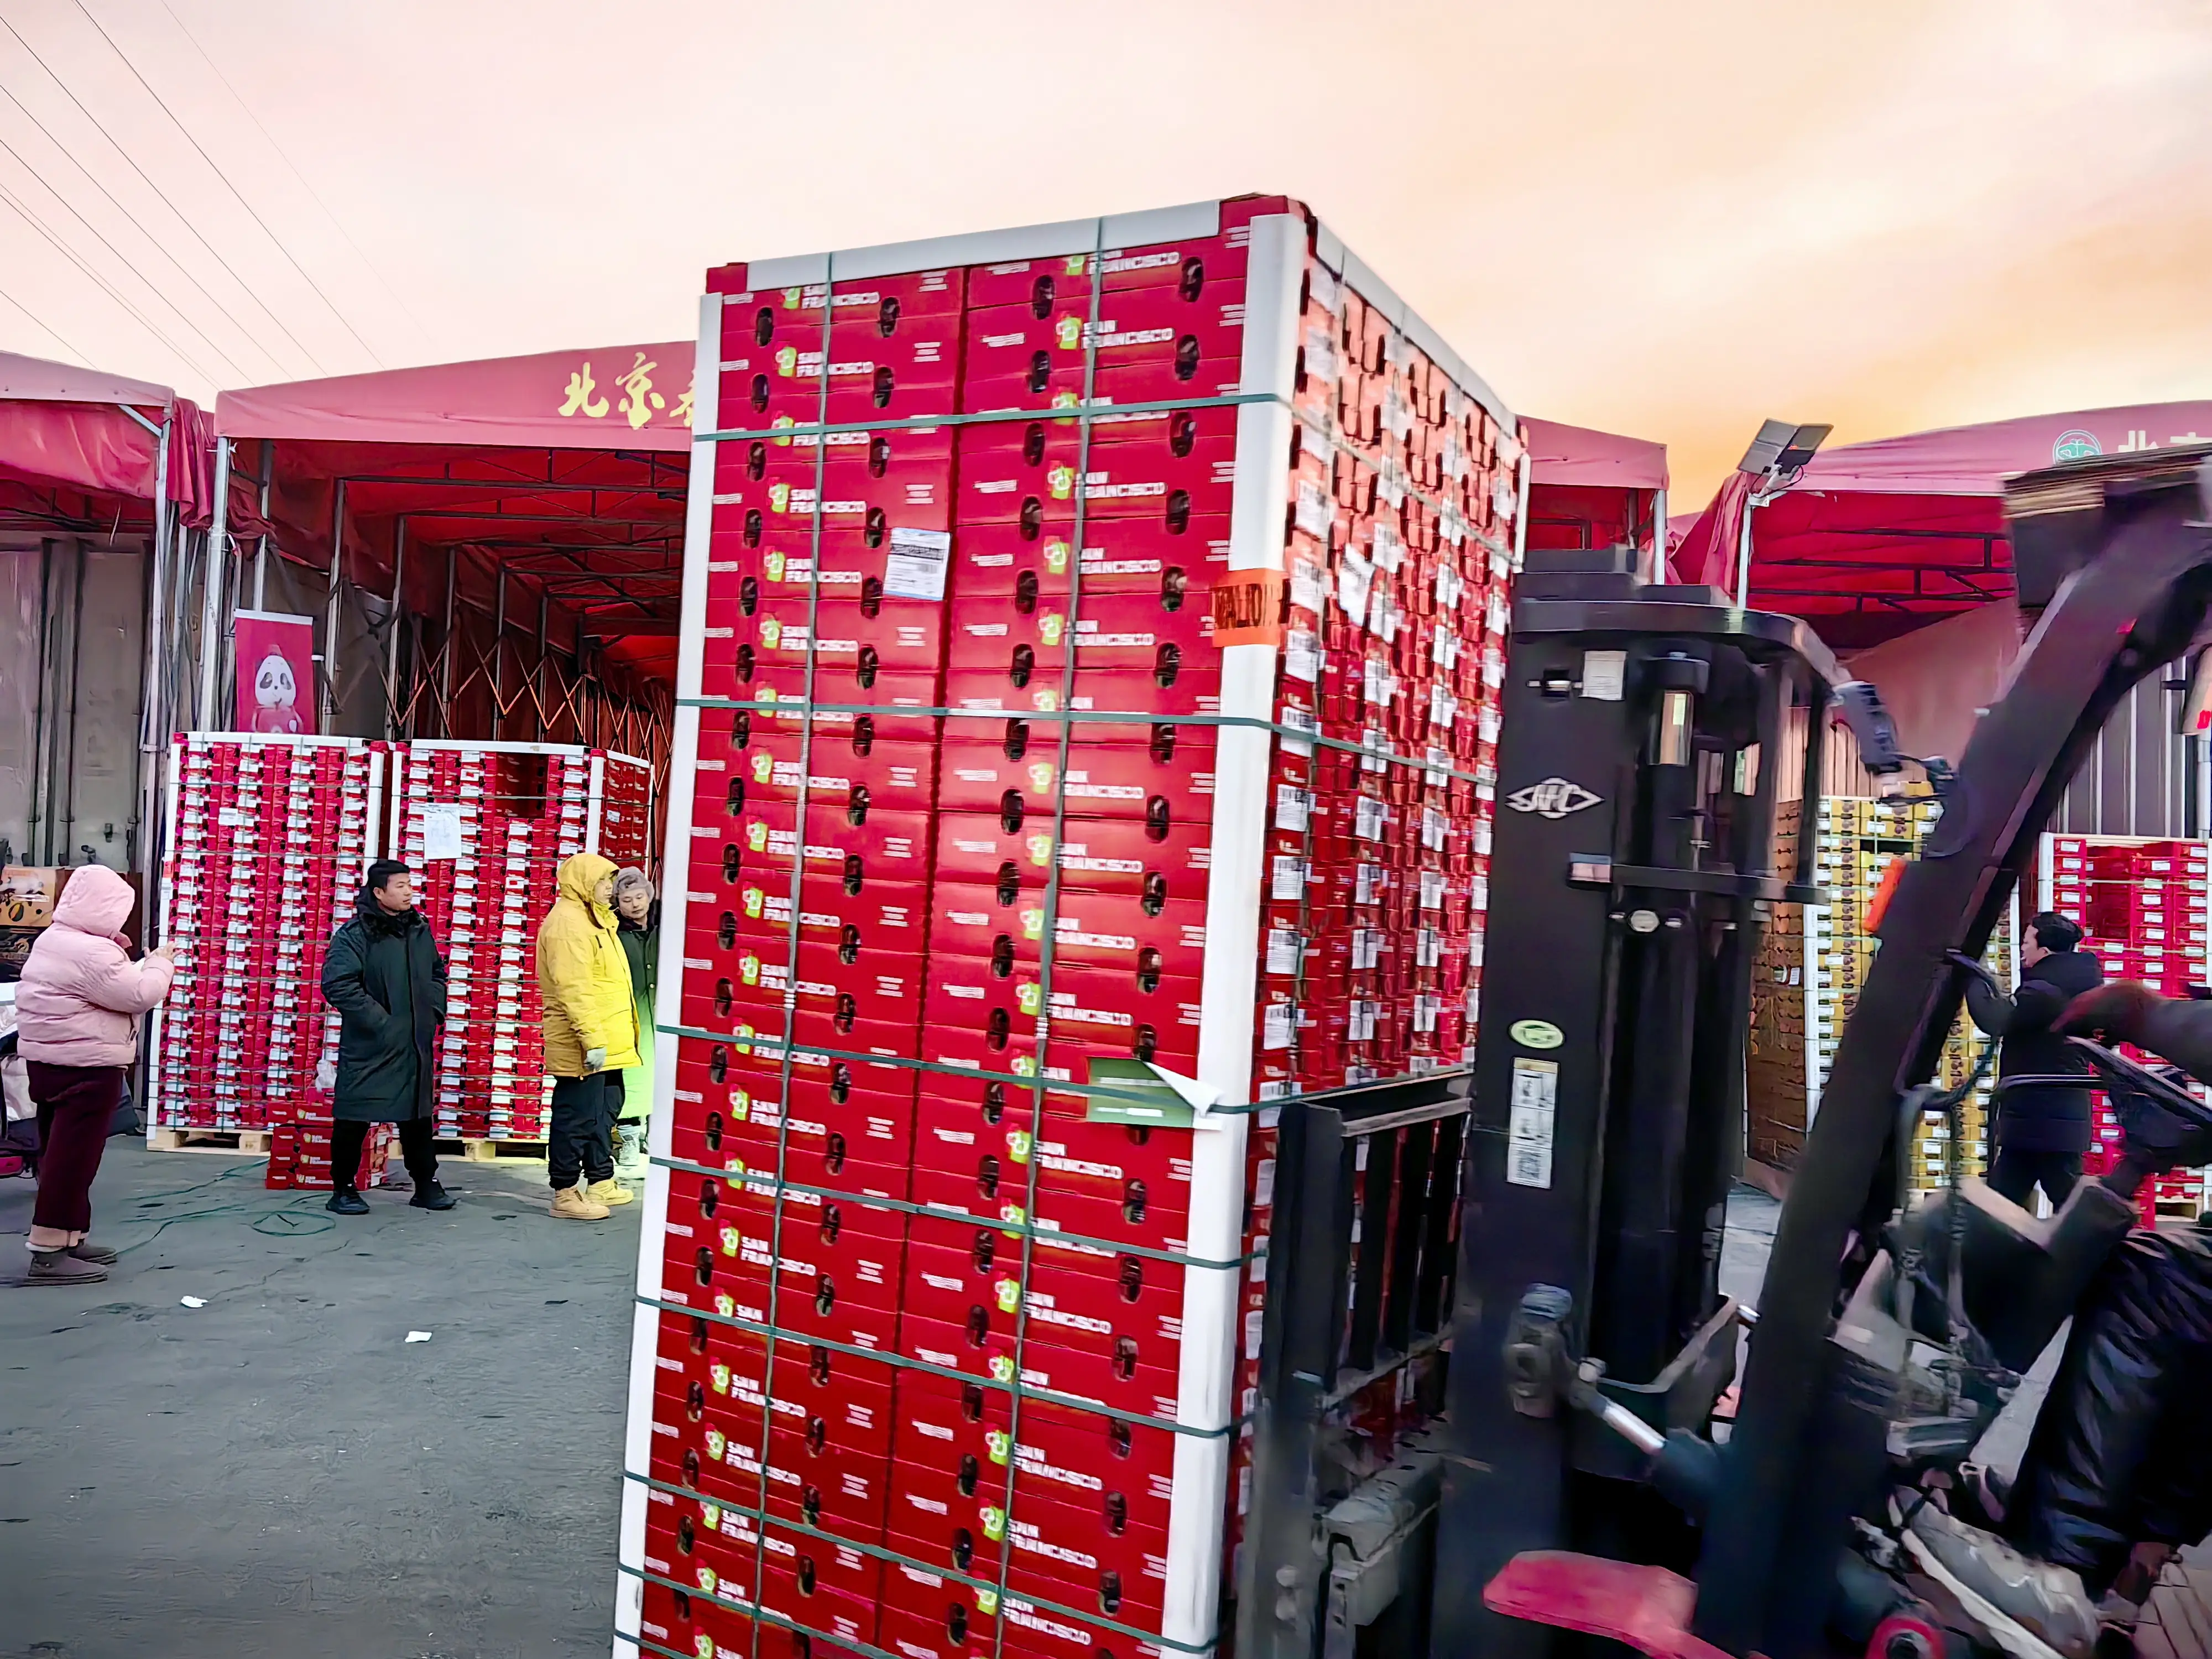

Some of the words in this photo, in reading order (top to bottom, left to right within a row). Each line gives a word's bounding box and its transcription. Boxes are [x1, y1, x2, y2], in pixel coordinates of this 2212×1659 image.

[1081, 560, 1162, 575] RANCISCO
[773, 774, 850, 790] FRACISCO
[1063, 783, 1145, 799] RANCISCO
[741, 1236, 769, 1253] SAN
[737, 1304, 763, 1321] SAN
[732, 1374, 760, 1391] SAN
